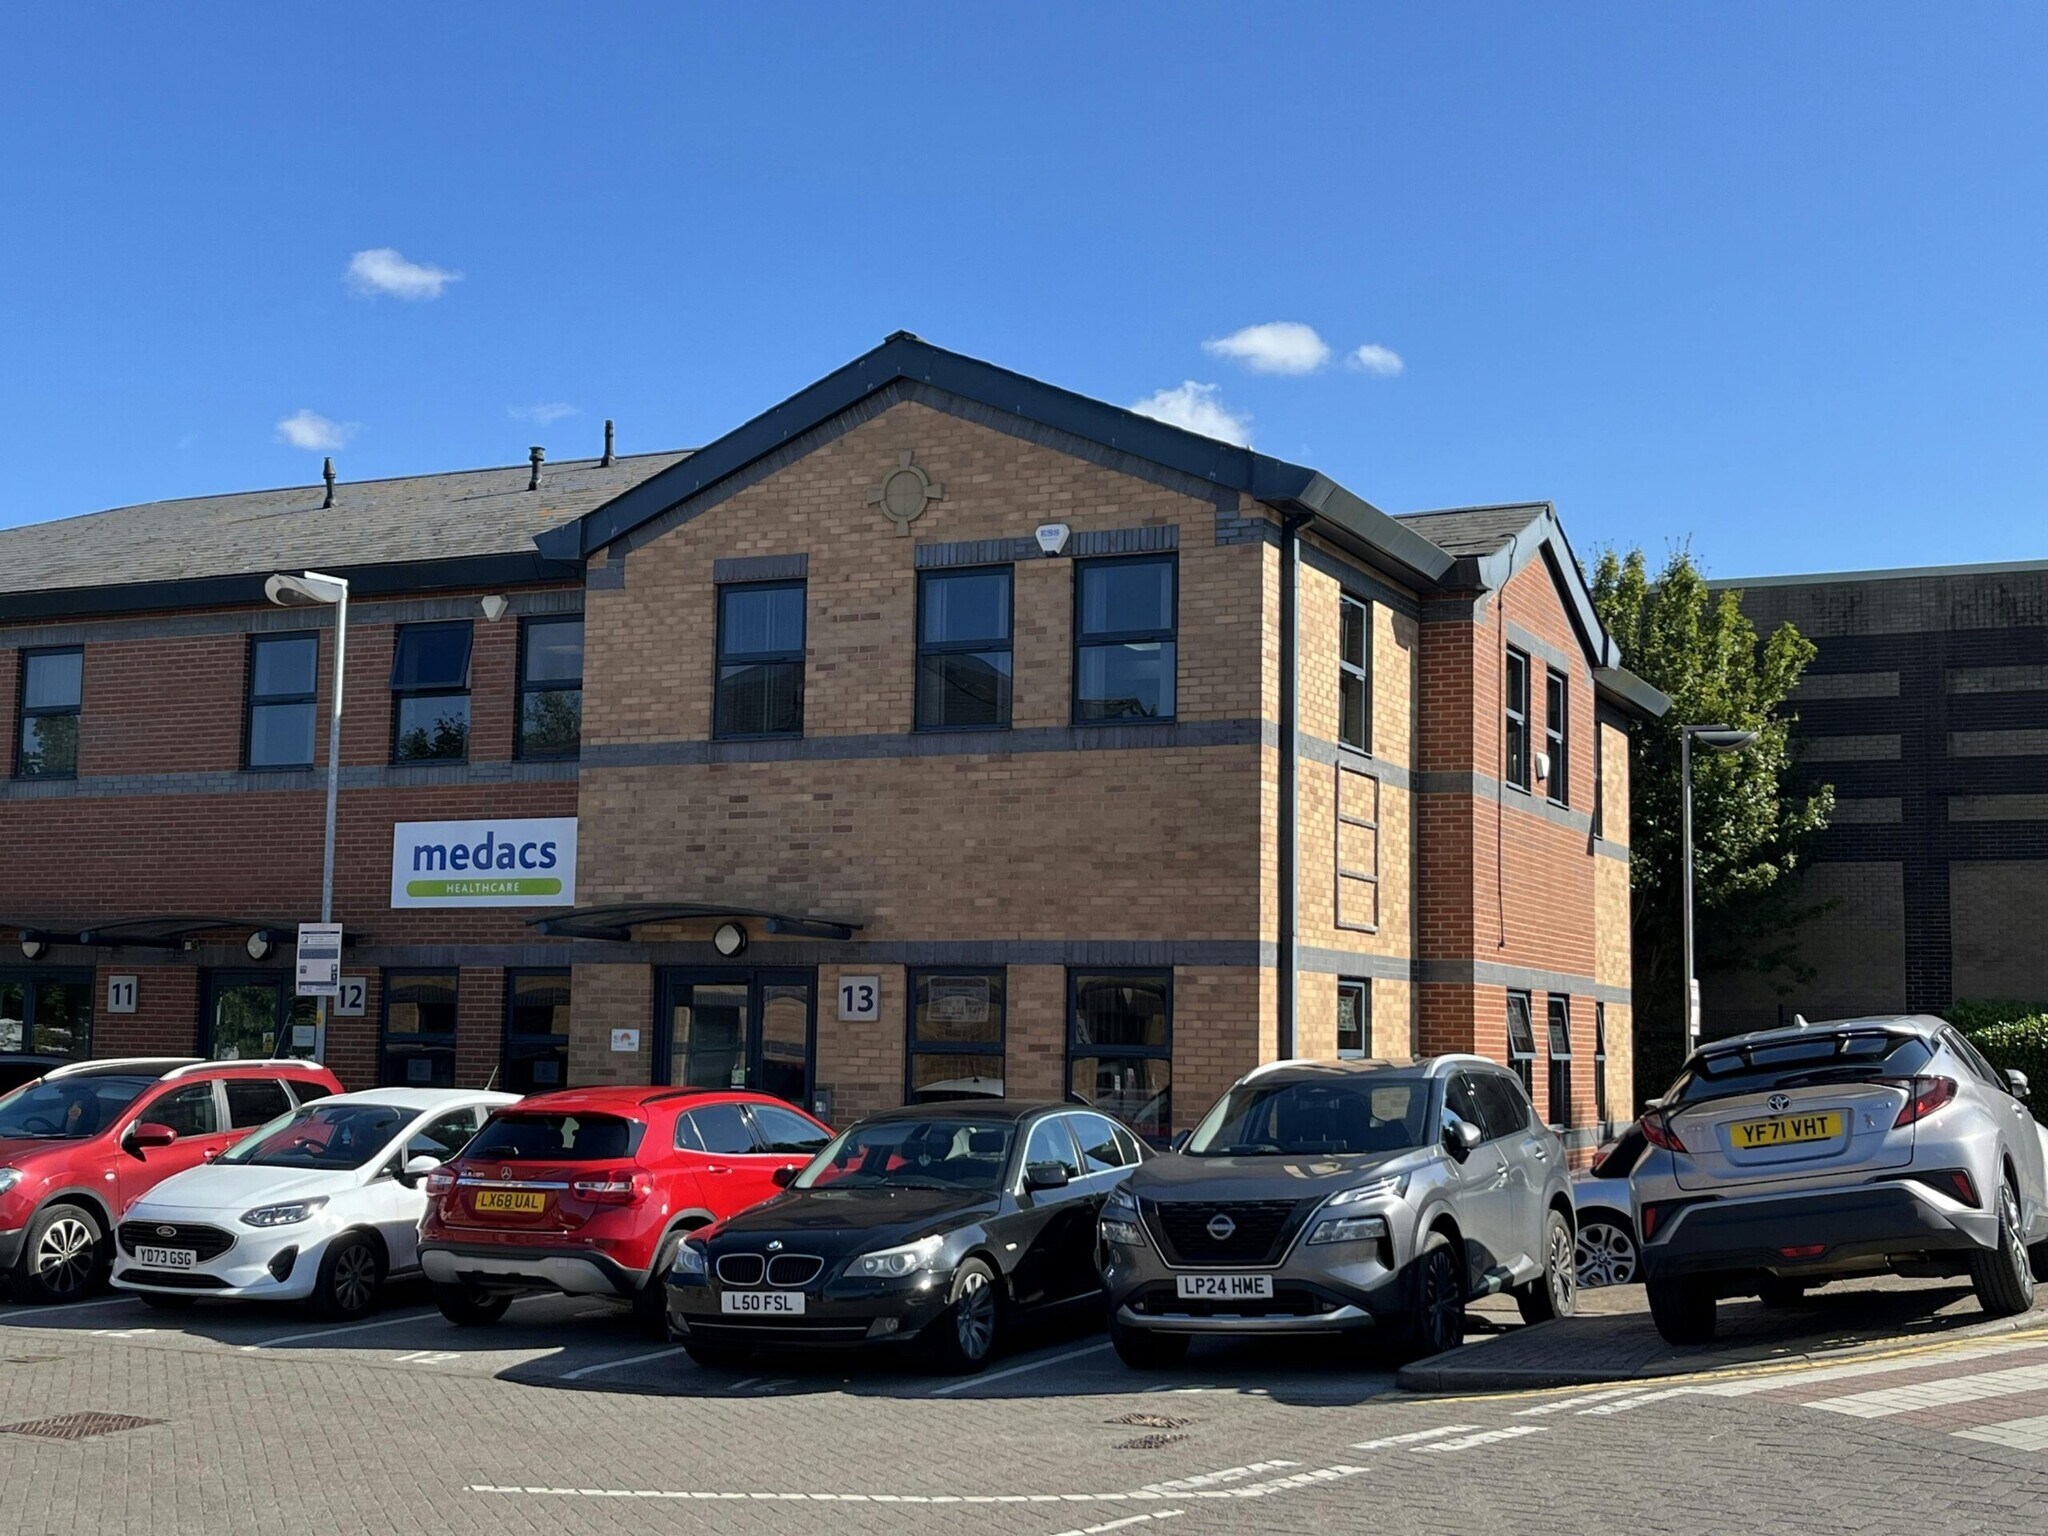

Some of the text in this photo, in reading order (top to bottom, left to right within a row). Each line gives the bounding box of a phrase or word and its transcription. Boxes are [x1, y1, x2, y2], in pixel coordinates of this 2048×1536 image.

[413, 831, 557, 871] medacs
[446, 882, 520, 894] HEALTHCARE
[112, 982, 133, 1005] 11
[339, 984, 363, 1009] 12
[842, 985, 874, 1012] 13
[1743, 1117, 1827, 1142] YF71 VHT
[480, 1192, 539, 1209] LX68 UAL
[140, 1247, 192, 1265] YD73 GSG
[1184, 1277, 1265, 1294] LP24 HME
[732, 1294, 793, 1311] L50 FSL
